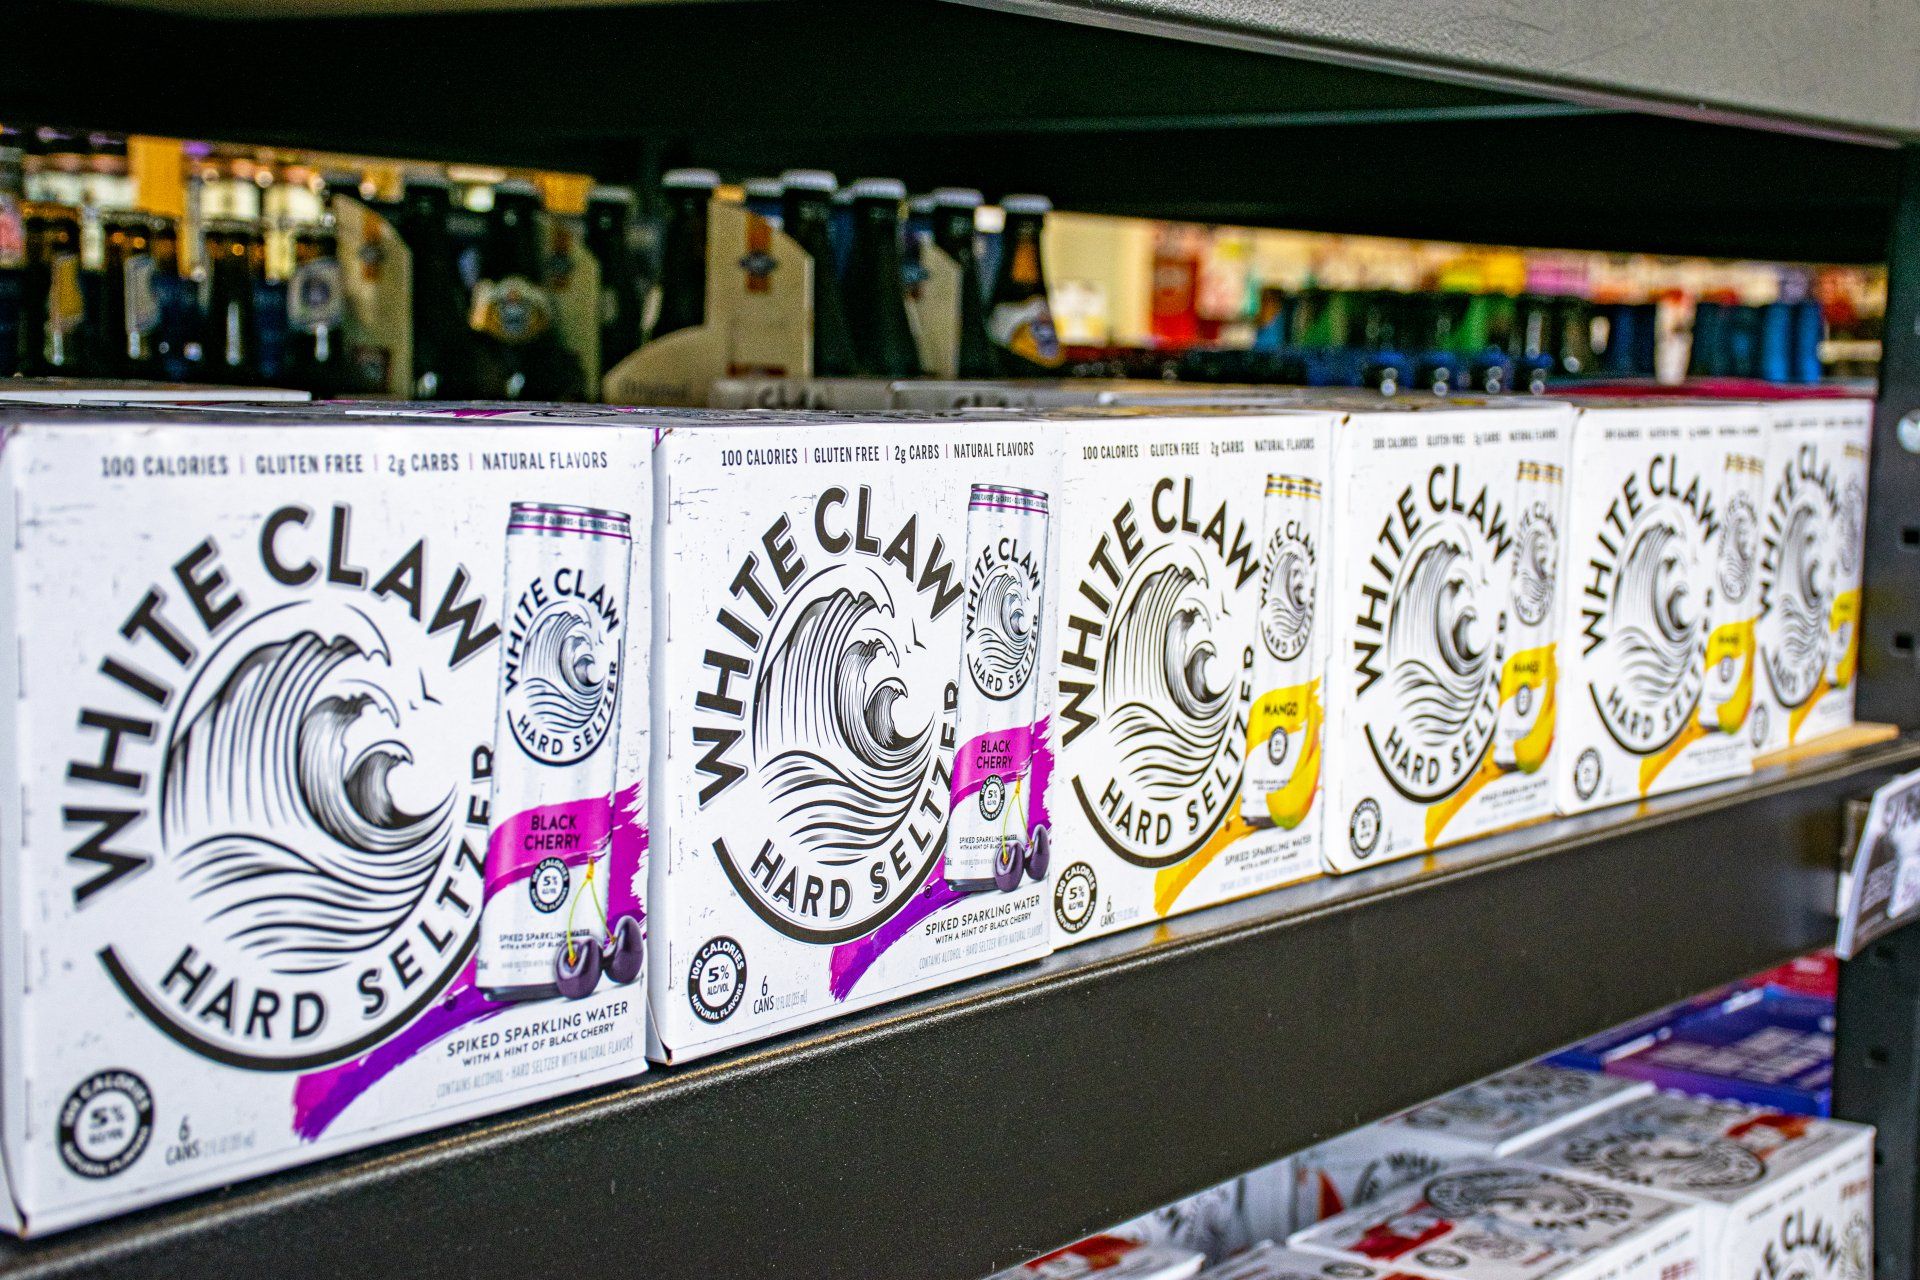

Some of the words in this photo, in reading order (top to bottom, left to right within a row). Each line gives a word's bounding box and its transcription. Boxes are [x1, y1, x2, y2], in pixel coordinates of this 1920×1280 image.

[721, 450, 743, 466] 100
[746, 448, 798, 465] CALORIES
[814, 446, 852, 463] GLUTEN
[855, 446, 880, 462] FREE
[894, 445, 906, 464] 2g
[909, 444, 940, 460] CARBS
[953, 443, 994, 459] NATURAL
[996, 441, 1035, 457] FLAVORS
[1083, 446, 1098, 460] 100
[1101, 444, 1139, 459] CALORIES
[1150, 443, 1179, 457] GLUTEN
[1181, 442, 1200, 456] FREE
[1222, 440, 1245, 453] CARBS
[101, 456, 136, 477] 100
[143, 455, 229, 476] CALORIES
[255, 454, 319, 475] GLUTEN
[324, 453, 364, 473] FREE
[388, 454, 406, 476] 2g
[411, 453, 459, 472] CARBS
[482, 452, 545, 471] NATURAL
[549, 451, 608, 469] FLAVORS
[1286, 520, 1315, 566] CLAW
[1581, 473, 1644, 657] WHITE
[1648, 454, 1721, 543] CLAW
[966, 544, 995, 642] WHITE
[998, 537, 1041, 590] CLAW
[1354, 485, 1421, 697] WHITE
[1428, 463, 1513, 562] CLAW
[1058, 498, 1144, 748] WHITE
[1152, 475, 1260, 591] CLAW
[505, 577, 548, 695] WHITE
[554, 567, 620, 633] CLAW
[692, 512, 806, 808] WHITE
[814, 485, 965, 621] CLAW
[973, 658, 1003, 691] HARD
[1009, 614, 1039, 690] SELTZER
[62, 535, 245, 907] WHITE
[259, 503, 501, 669] CLAW
[517, 715, 563, 755] HARD
[573, 661, 617, 752] SELTZER
[1263, 702, 1298, 716] MANGO
[981, 740, 1011, 753] BLACK
[1100, 777, 1171, 846] HARD
[1186, 644, 1253, 833] SELTZER
[1385, 726, 1440, 787] HARD
[976, 755, 1013, 769] CHERRY
[749, 838, 852, 920] HARD
[869, 679, 958, 901] SELTZER
[531, 814, 577, 831] BLACK
[524, 834, 581, 850] CHERRY
[162, 946, 327, 1042] HARD
[357, 742, 494, 1019] SELTZER
[1056, 879, 1067, 897] 100
[1064, 865, 1096, 891] CALORIES
[1069, 886, 1084, 900] 5%
[925, 917, 959, 936] SPIKED
[961, 903, 1011, 927] SPARKLING
[1013, 894, 1040, 911] WATER
[1106, 895, 1112, 913] 6
[935, 933, 953, 945] WITH
[954, 932, 960, 940] A
[961, 928, 977, 939] HINT
[978, 924, 988, 934] OF
[989, 919, 1009, 931] BLACK
[1009, 911, 1032, 926] CHERRY
[1100, 912, 1115, 928] CANS
[691, 958, 703, 979] 100
[702, 941, 745, 970] CALORIES
[919, 954, 941, 970] CONTAINS
[941, 949, 961, 963] ALCOHOL
[966, 943, 978, 957] HARD
[978, 938, 997, 953] SELTZER
[707, 964, 729, 983] 5%
[761, 975, 768, 996] 6
[691, 993, 720, 1020] NATURAL
[720, 983, 744, 1018] FLAVORS
[706, 983, 729, 996] ALC/VOL
[753, 995, 775, 1015] CANS
[447, 1032, 500, 1057] SPIKED
[504, 1012, 582, 1043] SPARKLING
[586, 1000, 628, 1023] WATER
[462, 1050, 490, 1066] WITH
[493, 1050, 501, 1060] A
[503, 1044, 528, 1058] HINT
[531, 1039, 545, 1051] OF
[549, 1031, 578, 1047] BLACK
[580, 1021, 615, 1040] CHERRY
[436, 1077, 471, 1099] CONTAINS
[473, 1069, 504, 1088] ALCOHOL
[511, 1062, 530, 1078] HARD
[532, 1055, 559, 1074] SELTZER
[561, 1051, 578, 1067] WITH
[579, 1043, 606, 1063] NATURAL
[607, 1034, 634, 1055] FLAVORS
[178, 1114, 191, 1142] 6
[165, 1139, 200, 1166] CANS
